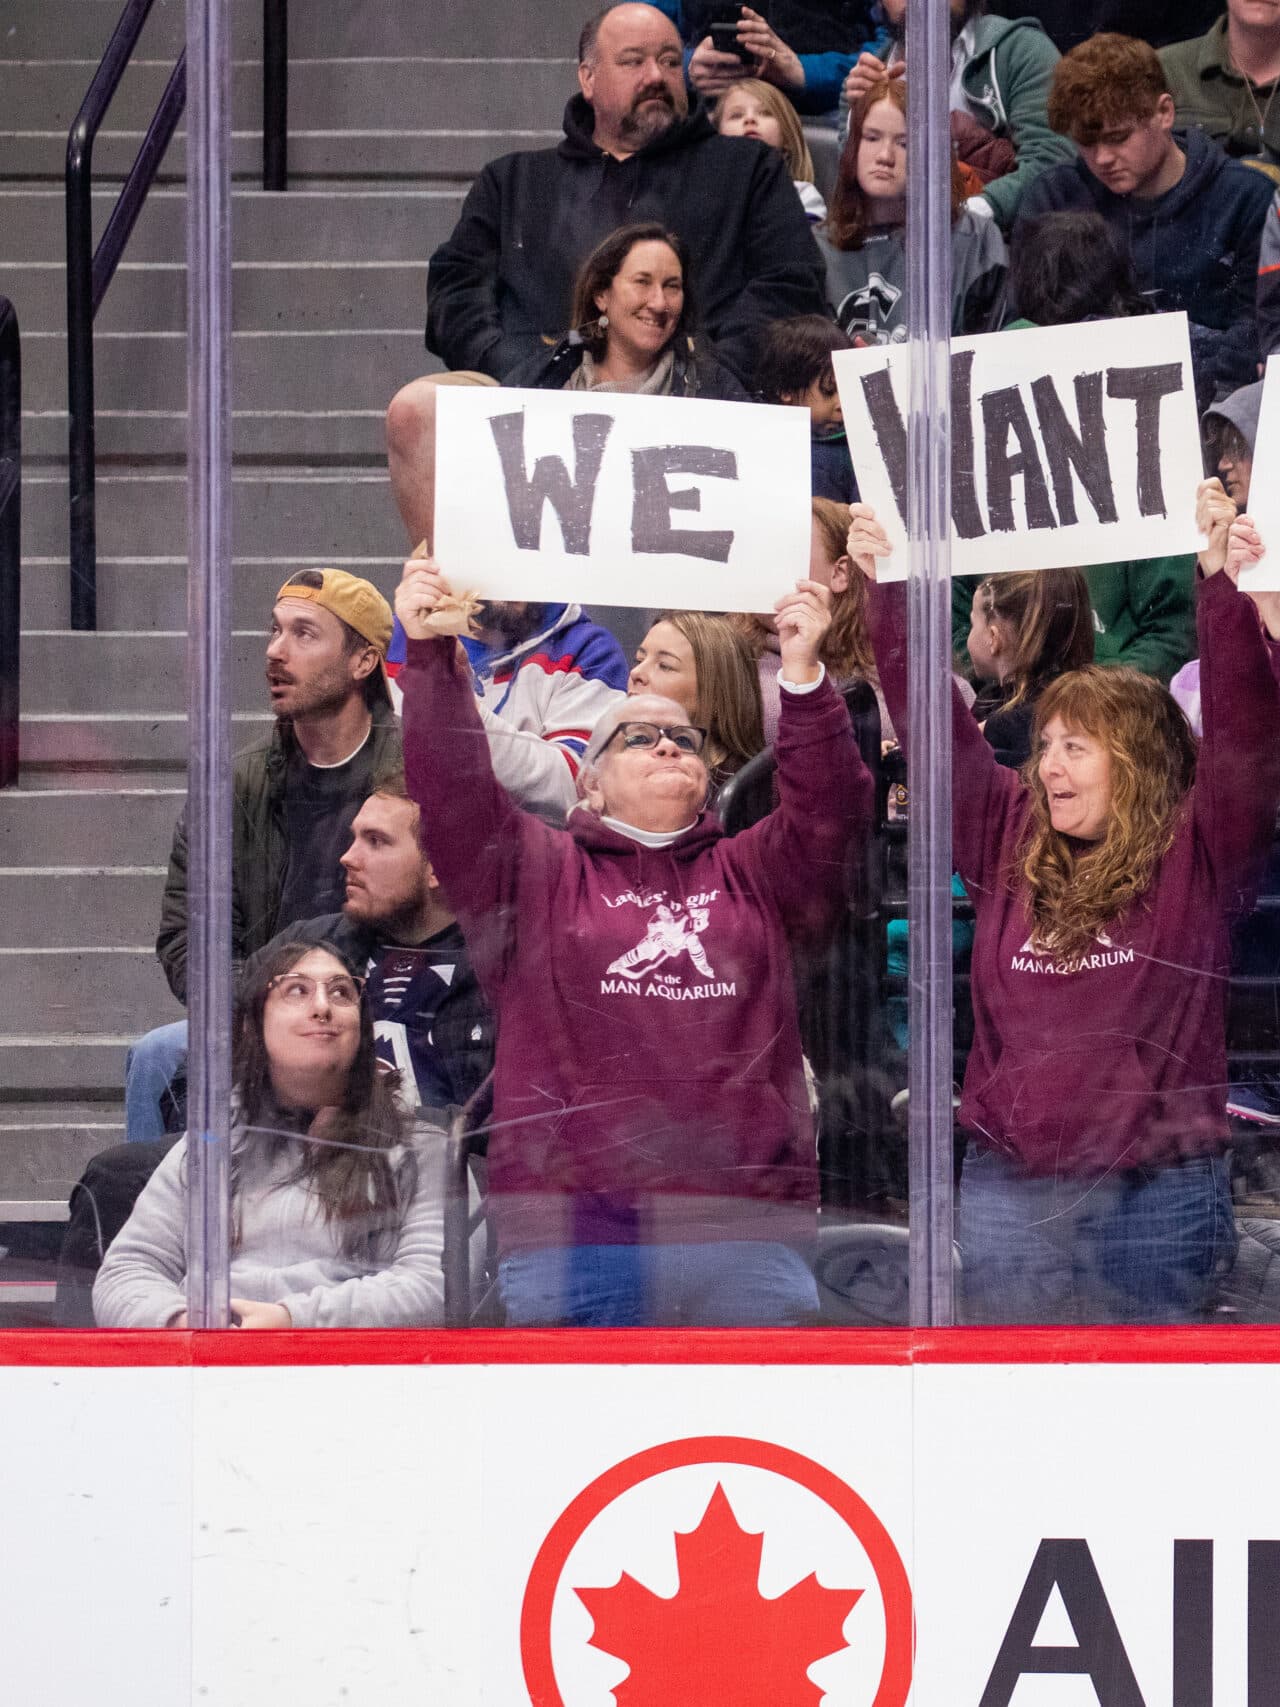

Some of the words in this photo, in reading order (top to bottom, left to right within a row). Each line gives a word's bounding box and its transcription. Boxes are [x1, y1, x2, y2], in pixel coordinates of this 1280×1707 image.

[860, 350, 1184, 540] WANT
[488, 406, 739, 563] WE
[1011, 956, 1044, 974] MAN
[1044, 949, 1134, 975] AQUARIUM
[600, 980, 641, 995] MAN
[644, 982, 737, 1001] AQUARIUM
[664, 974, 682, 985] the
